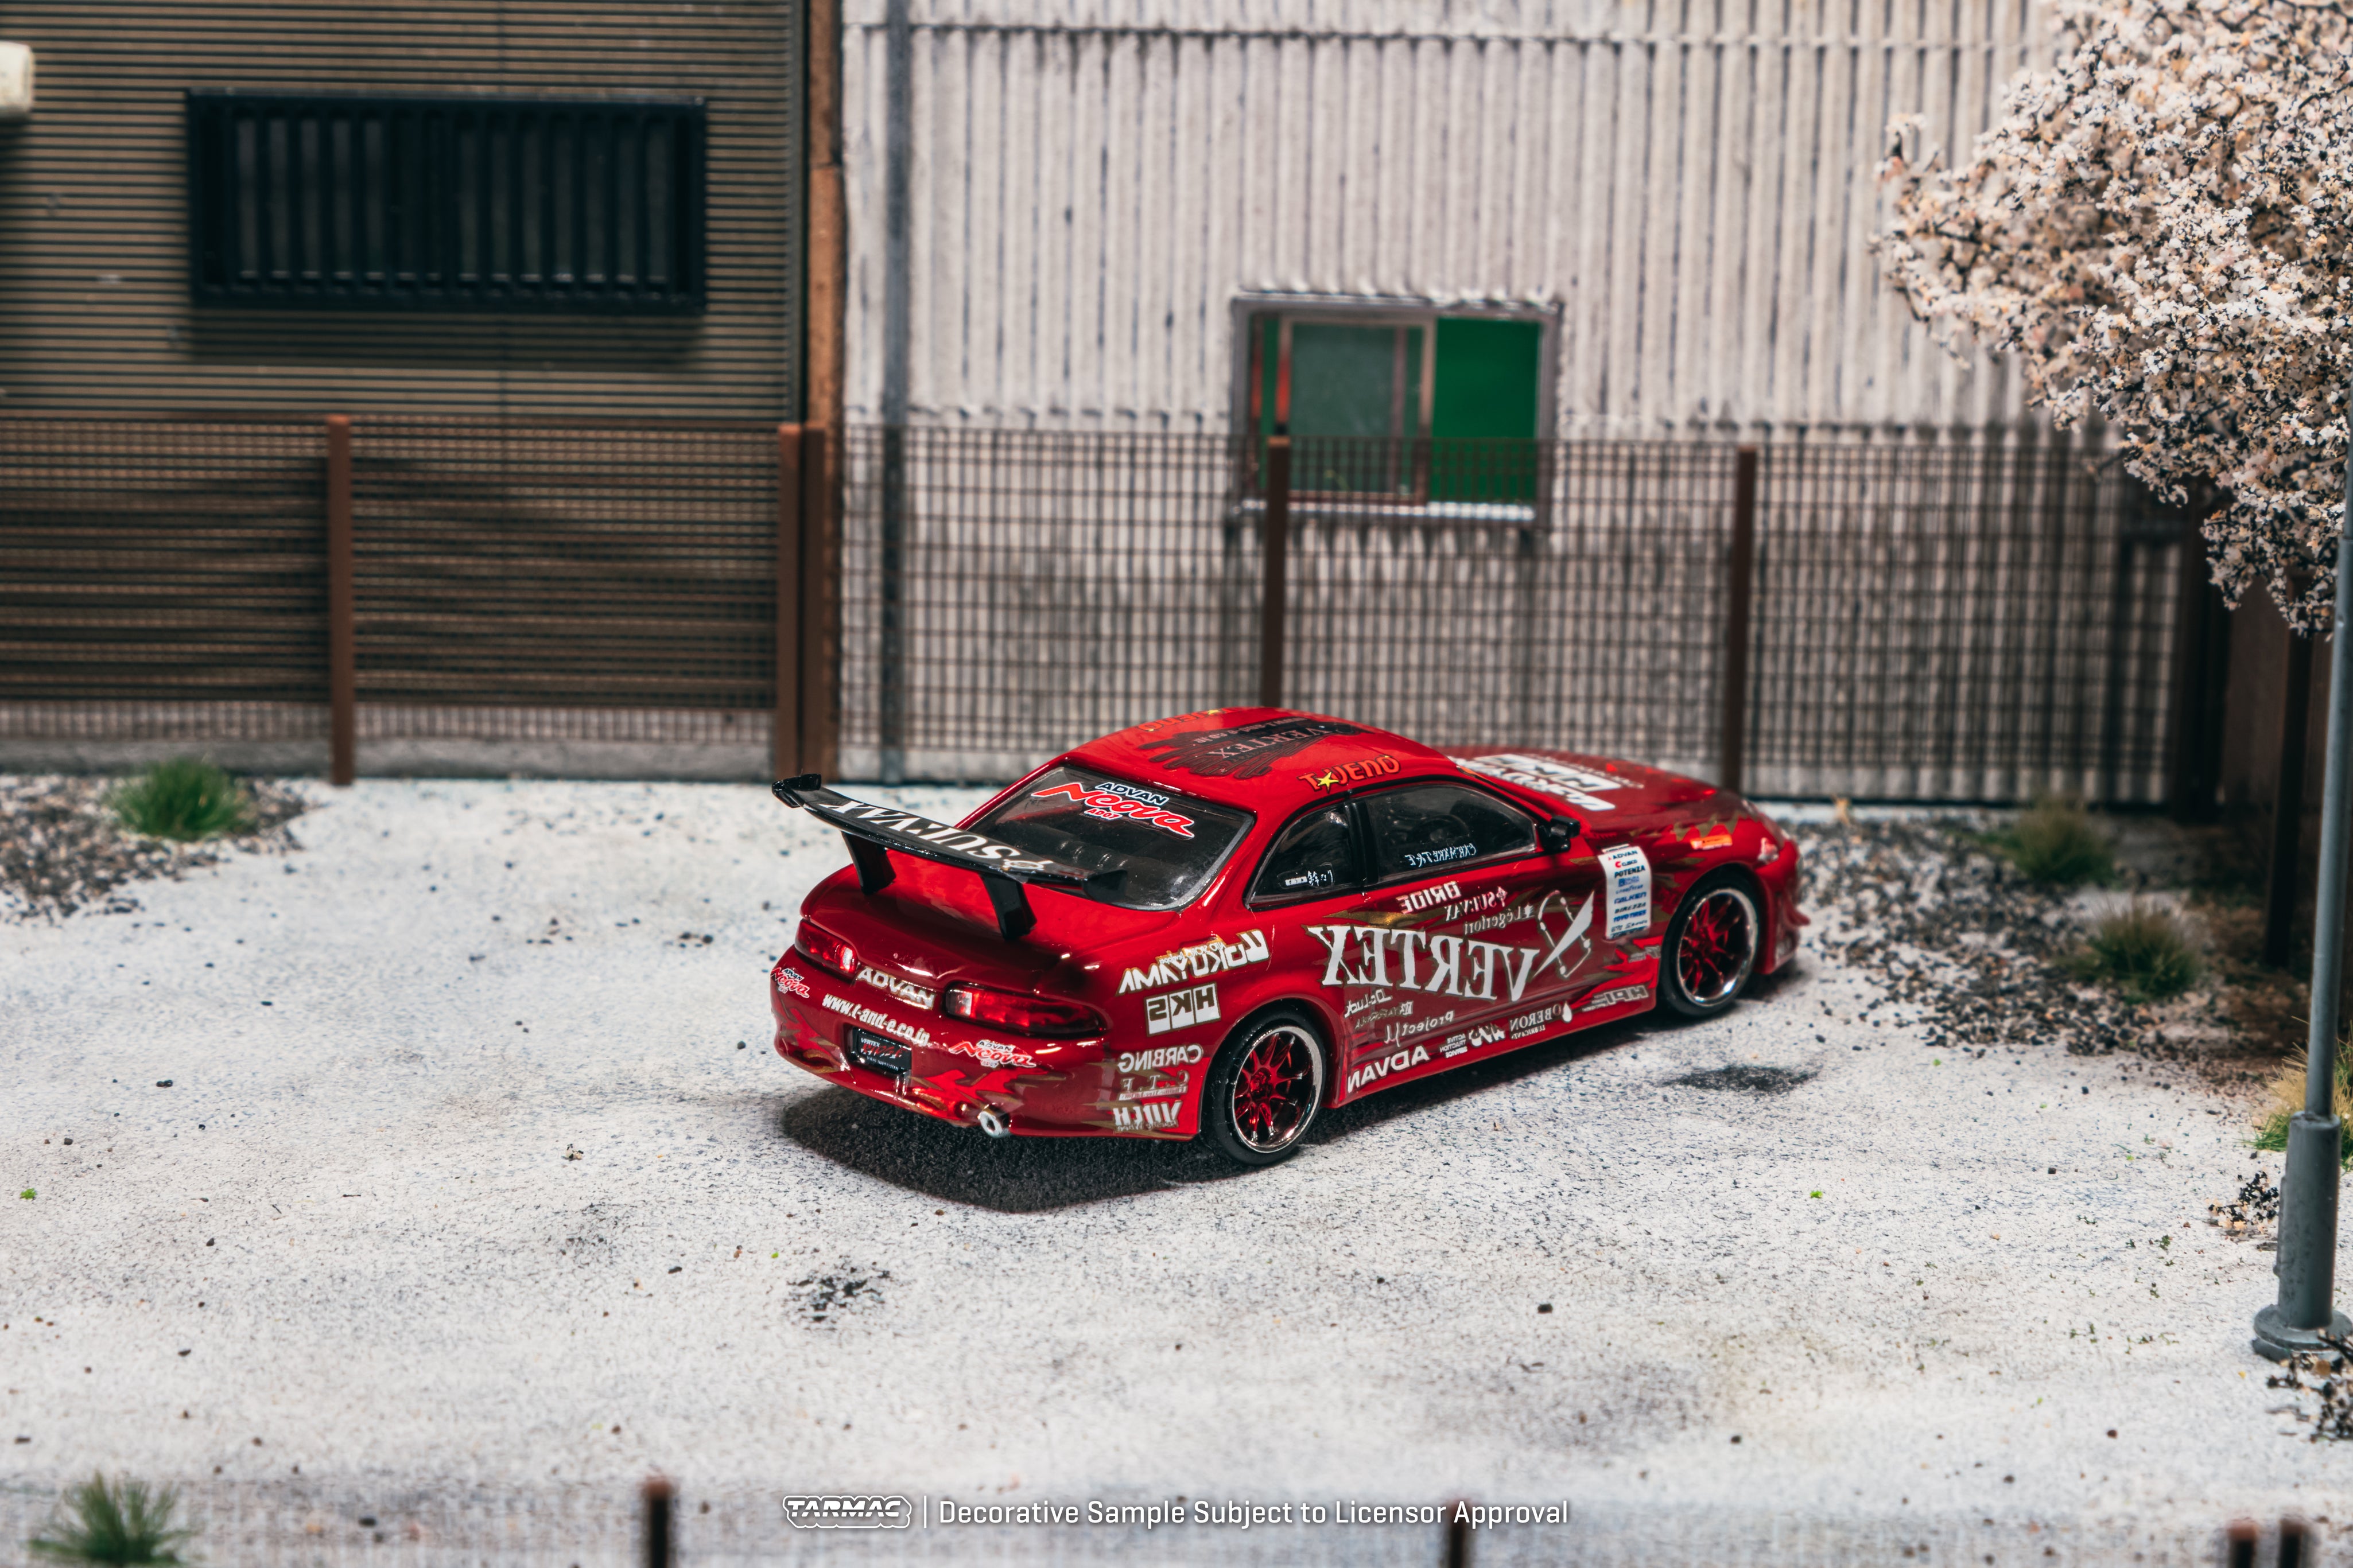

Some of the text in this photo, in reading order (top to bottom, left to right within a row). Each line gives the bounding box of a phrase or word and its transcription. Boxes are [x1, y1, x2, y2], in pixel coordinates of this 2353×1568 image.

[1207, 726, 1329, 758] VERTEX
[1095, 781, 1169, 806] ADVAN
[1031, 782, 1195, 839] Neova
[1084, 808, 1121, 820] AD07
[1613, 850, 1637, 859] ADVAN
[1614, 865, 1645, 878] POTENZA
[857, 966, 937, 1010] ADVAN
[949, 1041, 1036, 1068] Neova
[978, 1040, 1013, 1052] ADVAN
